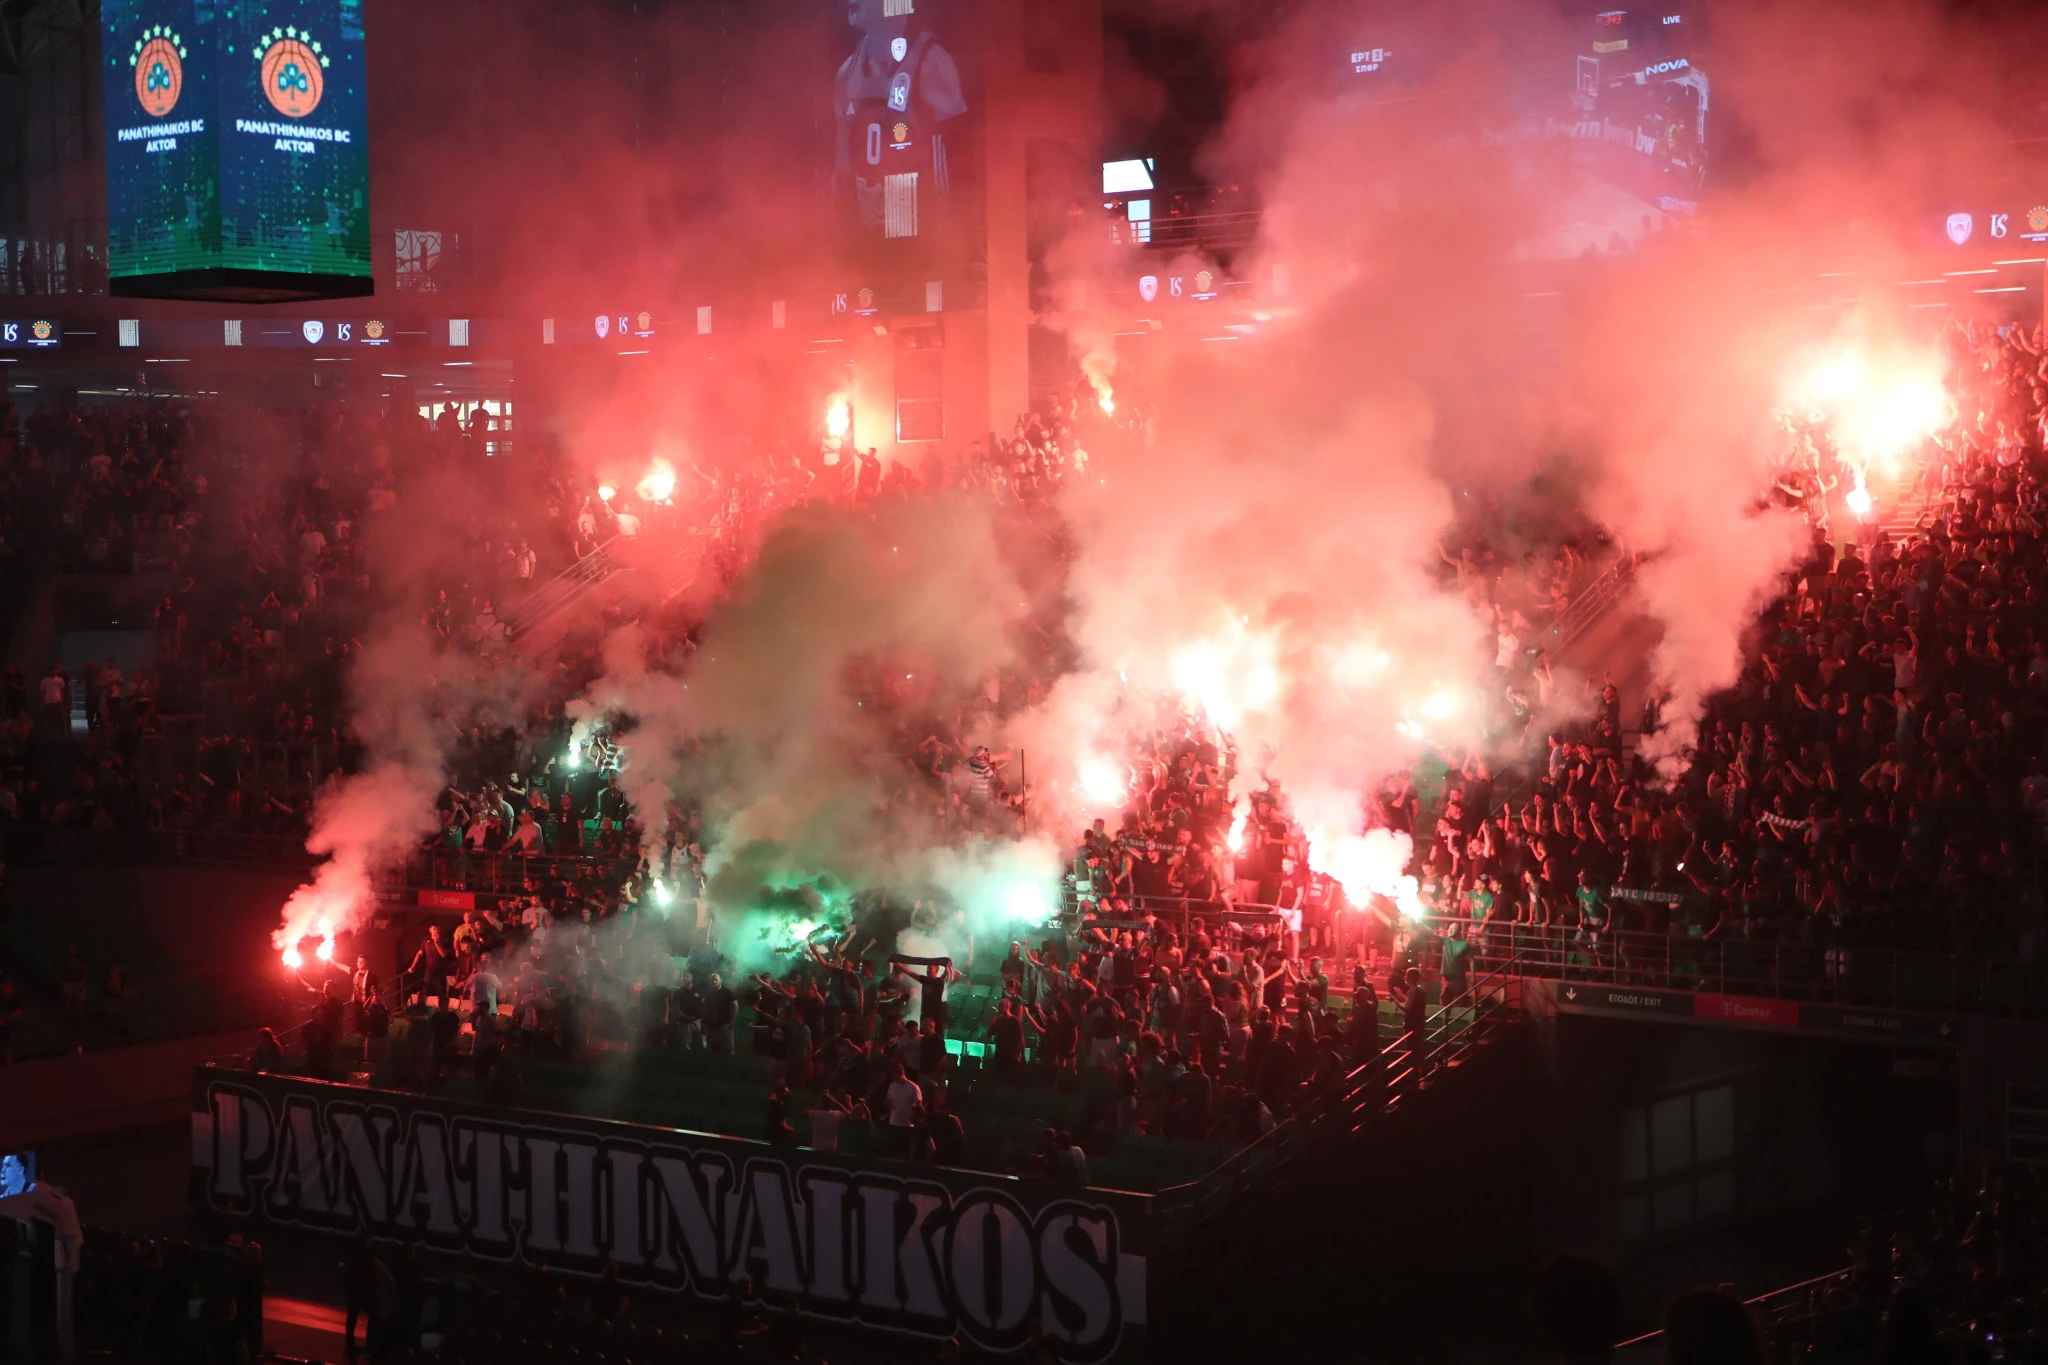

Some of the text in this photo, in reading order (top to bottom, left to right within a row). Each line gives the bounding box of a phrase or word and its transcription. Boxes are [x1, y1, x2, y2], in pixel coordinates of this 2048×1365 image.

[1662, 15, 1681, 25] LIVE
[1645, 58, 1690, 76] NOVA
[118, 120, 204, 142] PANATHINAIKOS BC
[236, 119, 351, 144] PANATHINAIKOS BC
[146, 138, 177, 153] AKTOR
[274, 138, 315, 154] AKTOR
[1644, 997, 1662, 1008] EXIT
[1734, 1003, 1771, 1019] Center
[208, 1088, 1118, 1348] PANATHINAIKOS
